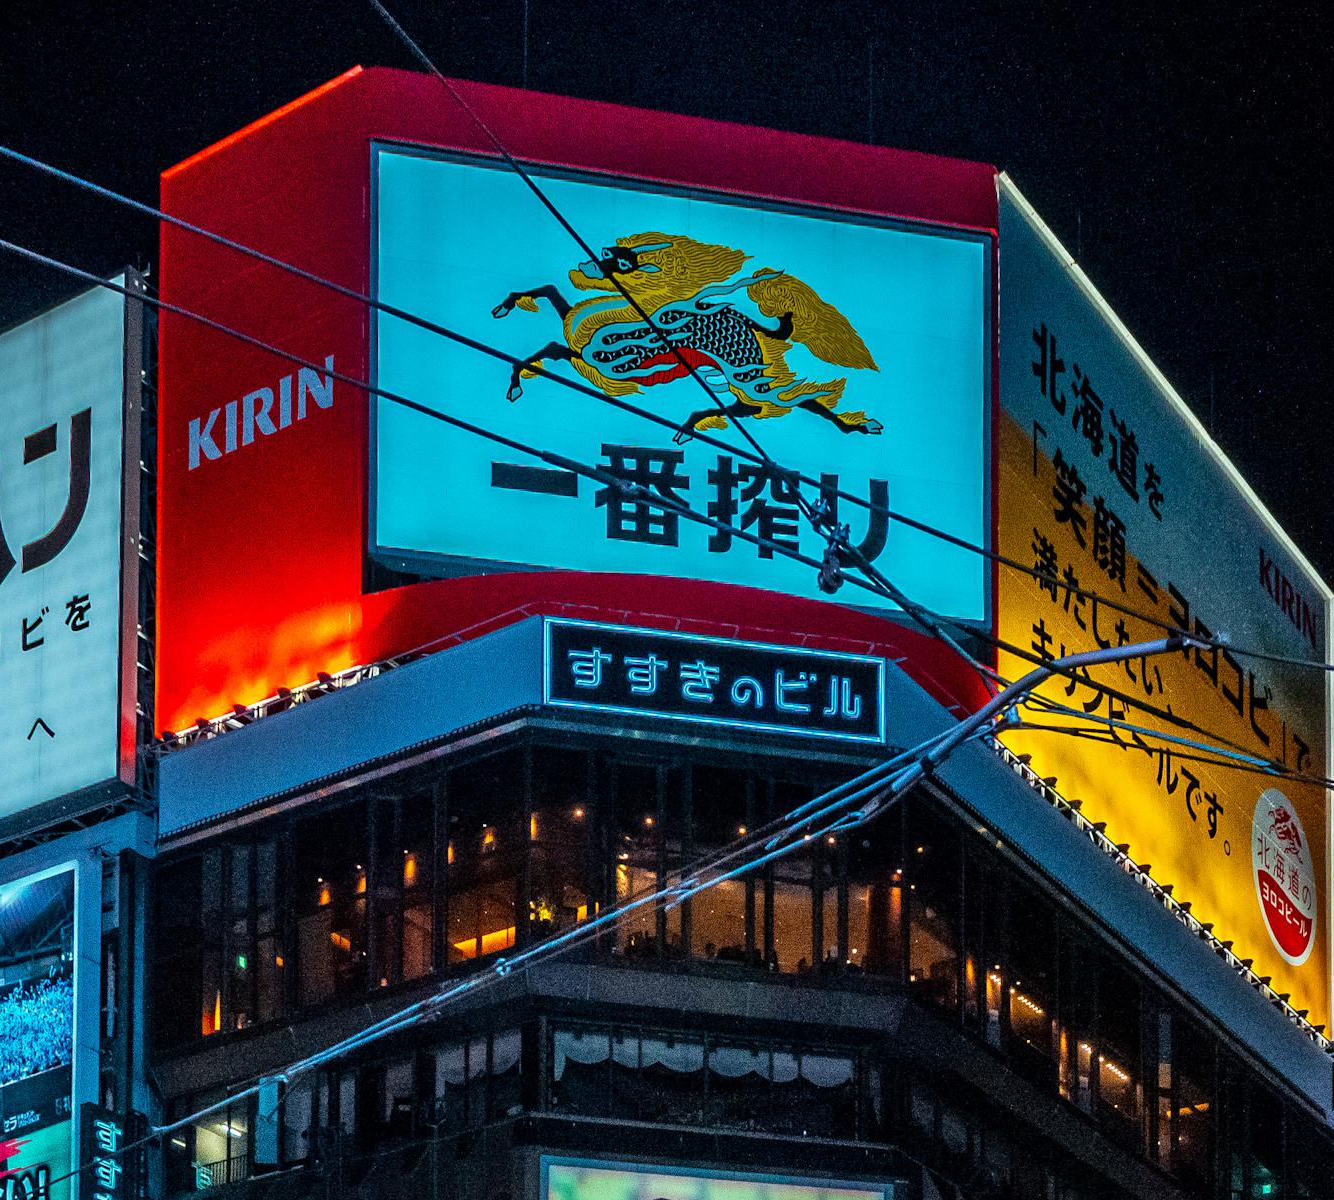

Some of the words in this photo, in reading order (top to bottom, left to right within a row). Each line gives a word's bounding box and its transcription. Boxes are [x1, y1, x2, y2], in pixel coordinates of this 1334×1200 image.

[186, 353, 336, 472] KIRIN
[1032, 321, 1165, 522] 北海道を
[490, 443, 891, 568] 一番搾り
[1260, 547, 1318, 651] KIRIN
[567, 646, 864, 720] すすきのビル
[1257, 835, 1313, 912] 北海道の
